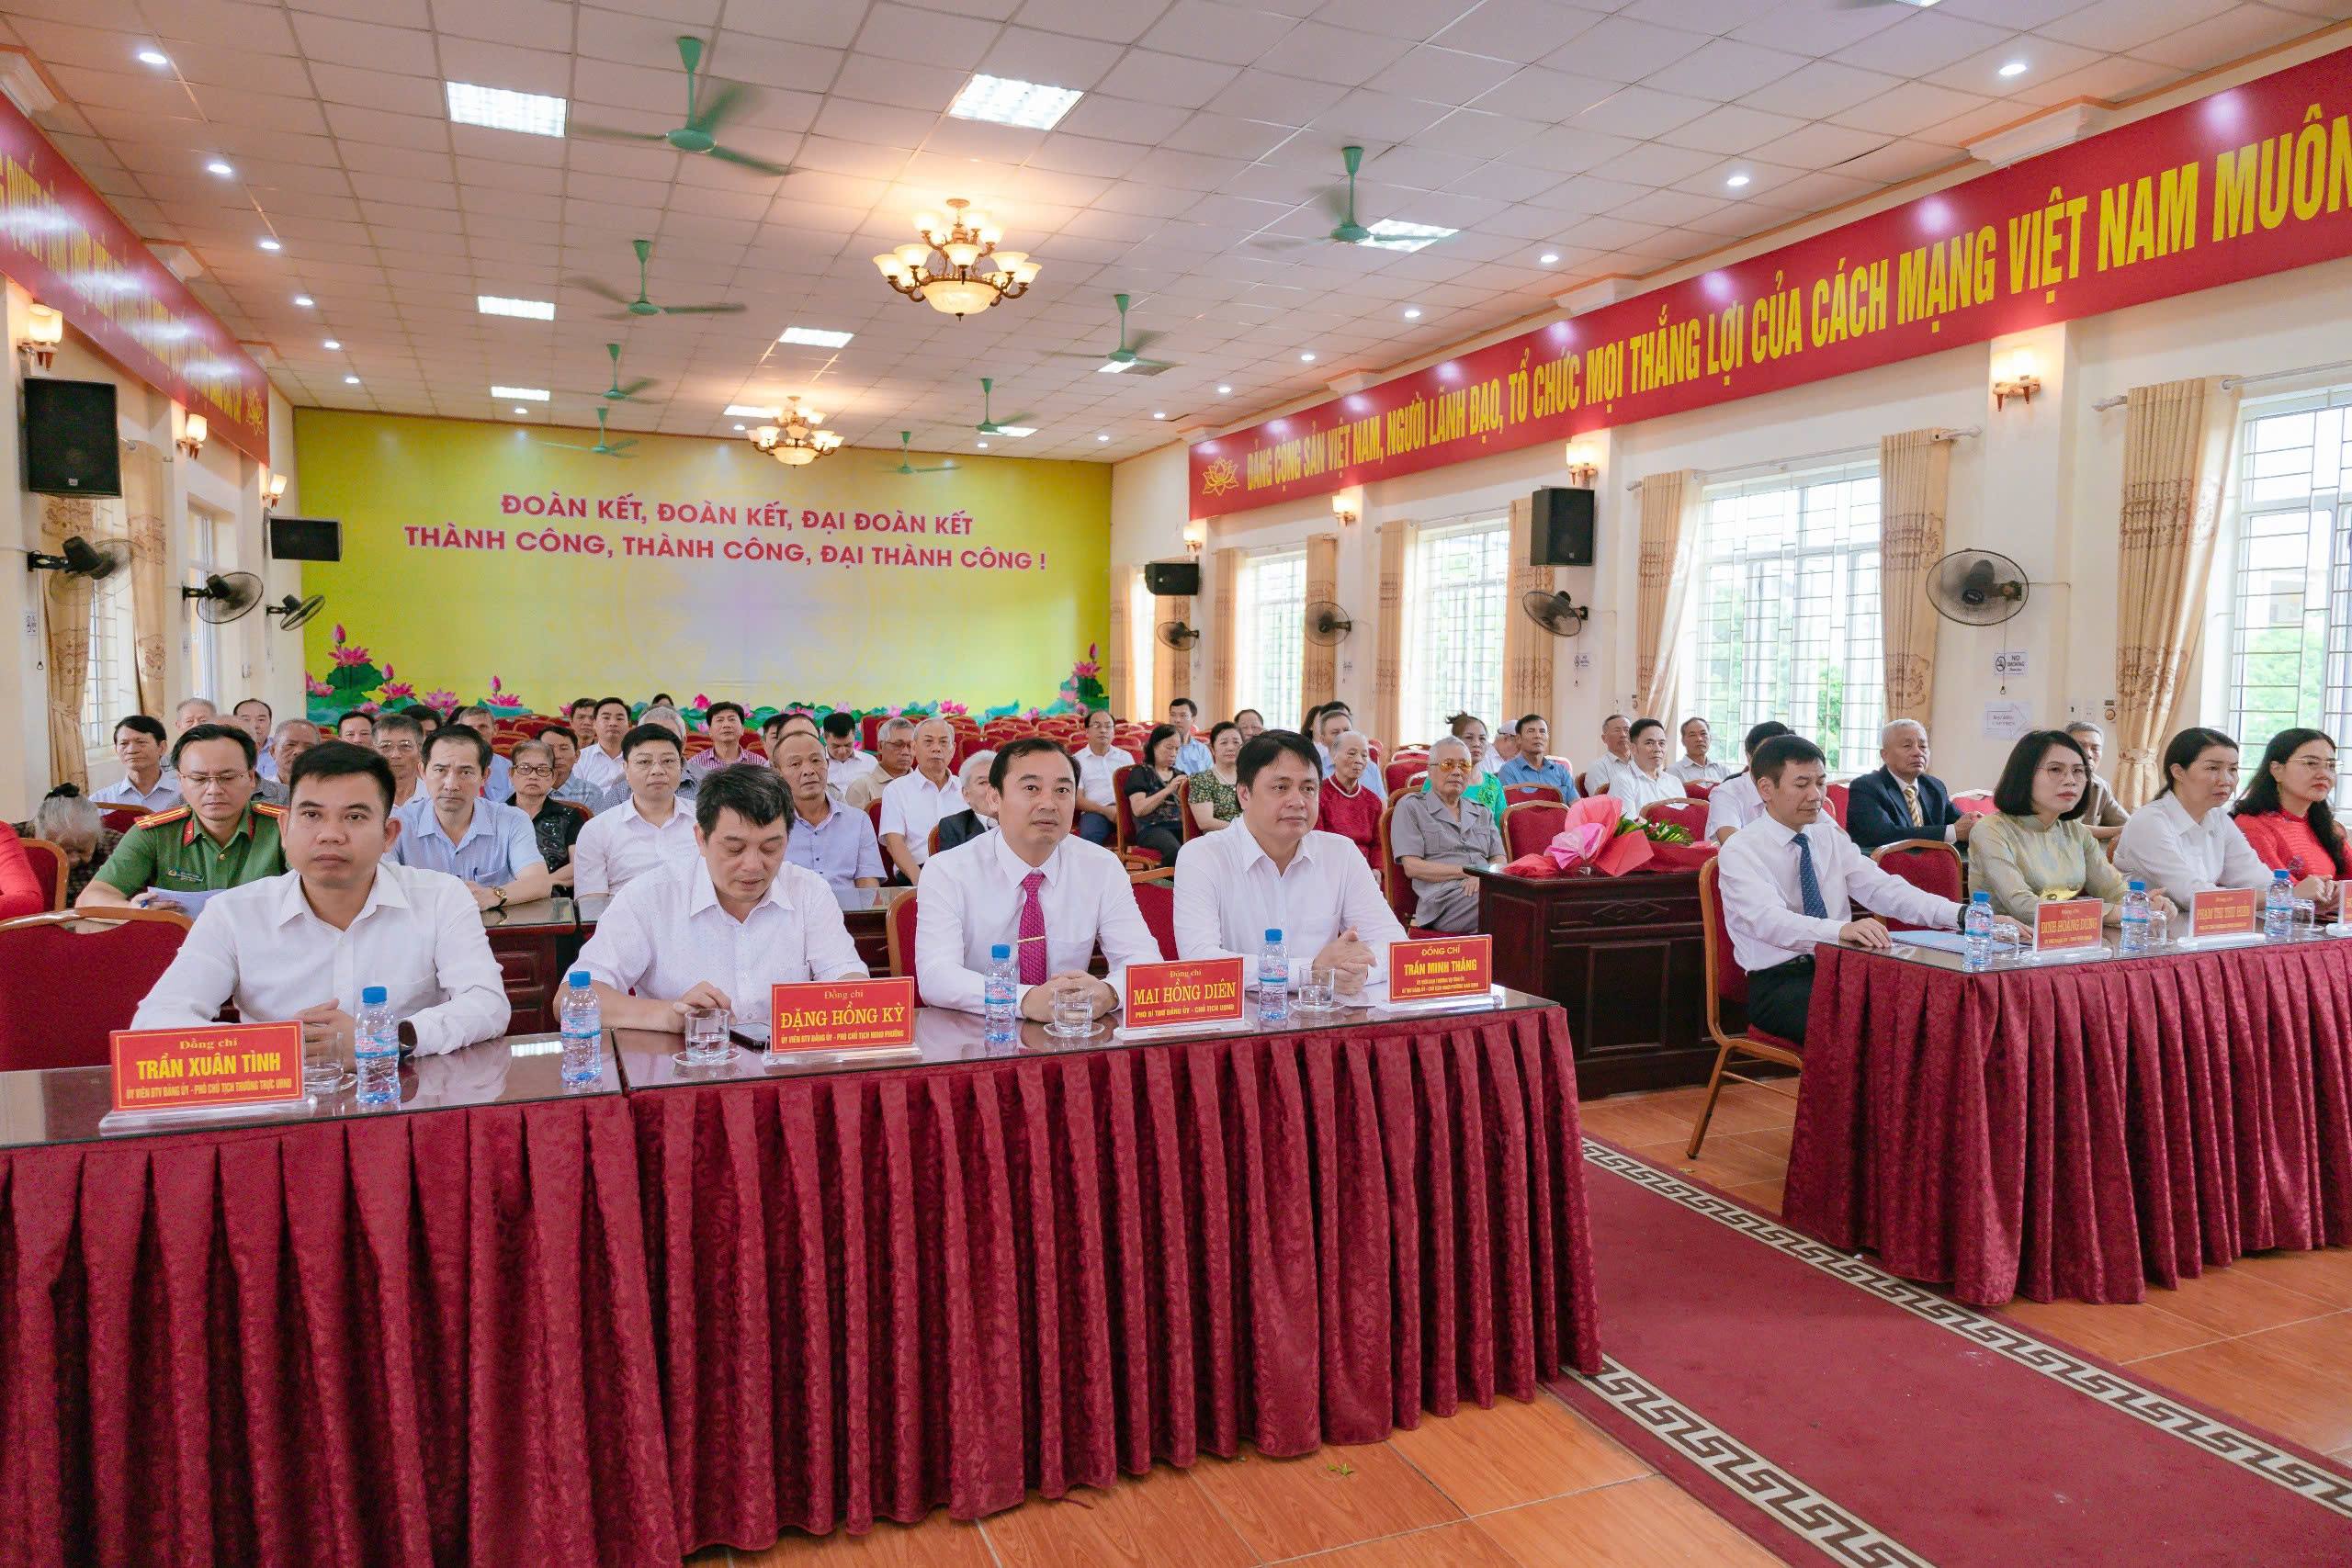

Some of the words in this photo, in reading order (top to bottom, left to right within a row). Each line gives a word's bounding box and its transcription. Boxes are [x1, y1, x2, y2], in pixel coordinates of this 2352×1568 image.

[1247, 439, 1272, 491] ĐẢNG
[1304, 420, 1326, 477] SẢN
[1328, 417, 1351, 479] VIỆT
[1352, 415, 1385, 465] NAM,
[1429, 386, 1466, 446] LÃNH
[1469, 378, 1504, 444] ĐẠO,
[1508, 347, 1529, 425] TỔ
[1532, 341, 1581, 421] CHỨC
[1585, 340, 1624, 413] MỌI
[1630, 303, 1701, 391] THẮNG
[1707, 299, 1746, 386] LỢI
[1751, 269, 1804, 364] CỦA
[1811, 257, 1889, 347] CÁCH
[1897, 225, 1997, 333] MẠNG
[2008, 186, 2088, 304] VIỆT
[2098, 161, 2199, 272] NAM
[2212, 103, 2352, 243] MUÔN
[501, 493, 587, 518] ĐOÀN
[597, 492, 648, 524] KẾT,
[656, 499, 736, 525] ĐOÀN
[745, 500, 793, 530] KẾT,
[801, 509, 846, 533] ĐẠI
[854, 506, 926, 535] ĐOÀN
[934, 507, 974, 536] KẾT
[404, 525, 506, 551] THÀNH
[514, 526, 614, 559] CÔNG,
[622, 534, 717, 559] THÀNH
[723, 536, 812, 567] CÔNG,
[820, 545, 865, 569] ĐẠI
[871, 543, 954, 569] THÀNH
[960, 544, 1033, 570] CÔNG
[1427, 962, 1449, 975] MINH
[850, 989, 864, 998] chí
[1134, 988, 1159, 1005] MAI
[1163, 978, 1202, 1003] HỒNG
[1204, 978, 1236, 999] DIÊN
[781, 1008, 828, 1032] ĐẶNG
[831, 1001, 877, 1026] HỒNG
[882, 1002, 905, 1022] KỲ
[180, 1038, 214, 1050] Đồng
[218, 1036, 237, 1047] chí
[136, 1053, 183, 1080] TRẦN
[188, 1052, 236, 1077] XUÂN
[242, 1050, 280, 1073] TÌNH
